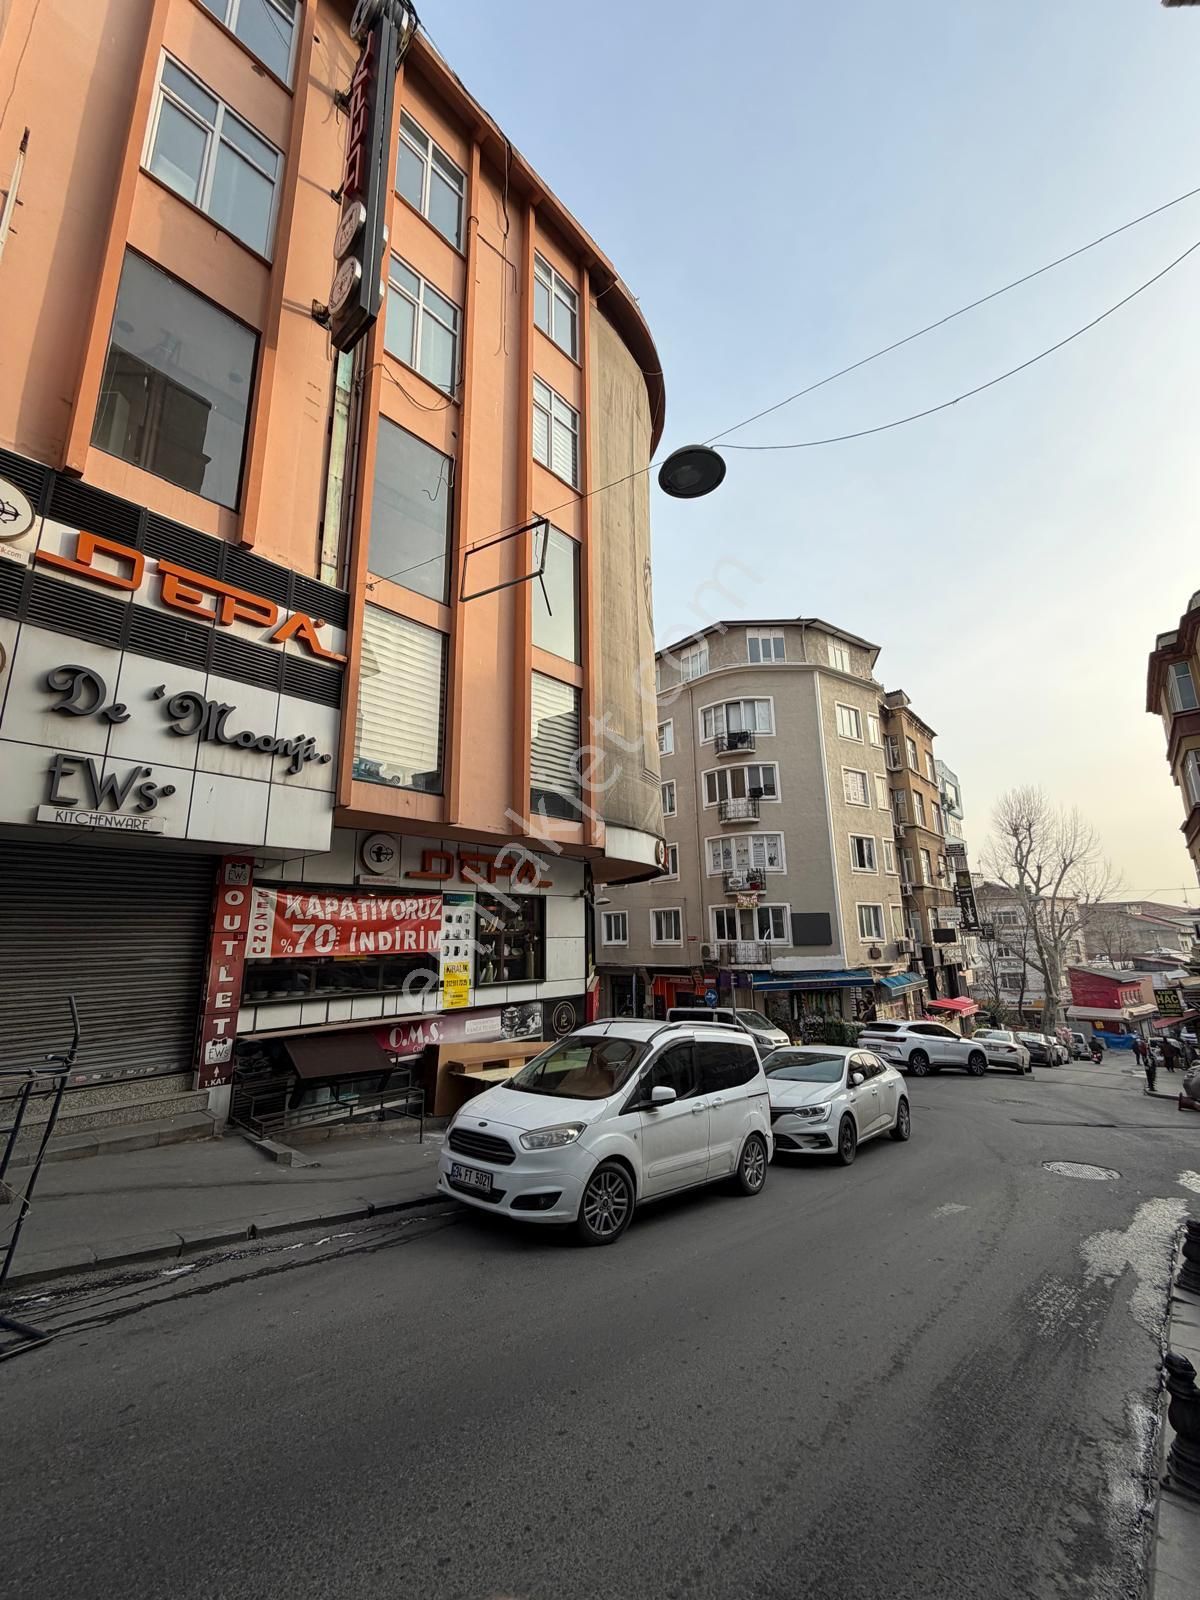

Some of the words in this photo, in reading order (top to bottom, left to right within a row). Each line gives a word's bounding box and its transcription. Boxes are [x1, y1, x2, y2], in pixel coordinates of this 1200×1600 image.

[35, 530, 348, 663] DEPA
[55, 808, 150, 831] KITCHENWARE
[405, 849, 553, 888] DEPA
[285, 894, 442, 921] KAPATIYORUZ
[252, 891, 270, 954] SEZONU
[349, 925, 442, 953] İNDİRİM
[213, 890, 244, 1034] OUTLET
[390, 1022, 444, 1048] O.M.S.
[210, 1077, 226, 1086] KAT
[455, 1166, 462, 1179] 34
[464, 1168, 472, 1182] FT
